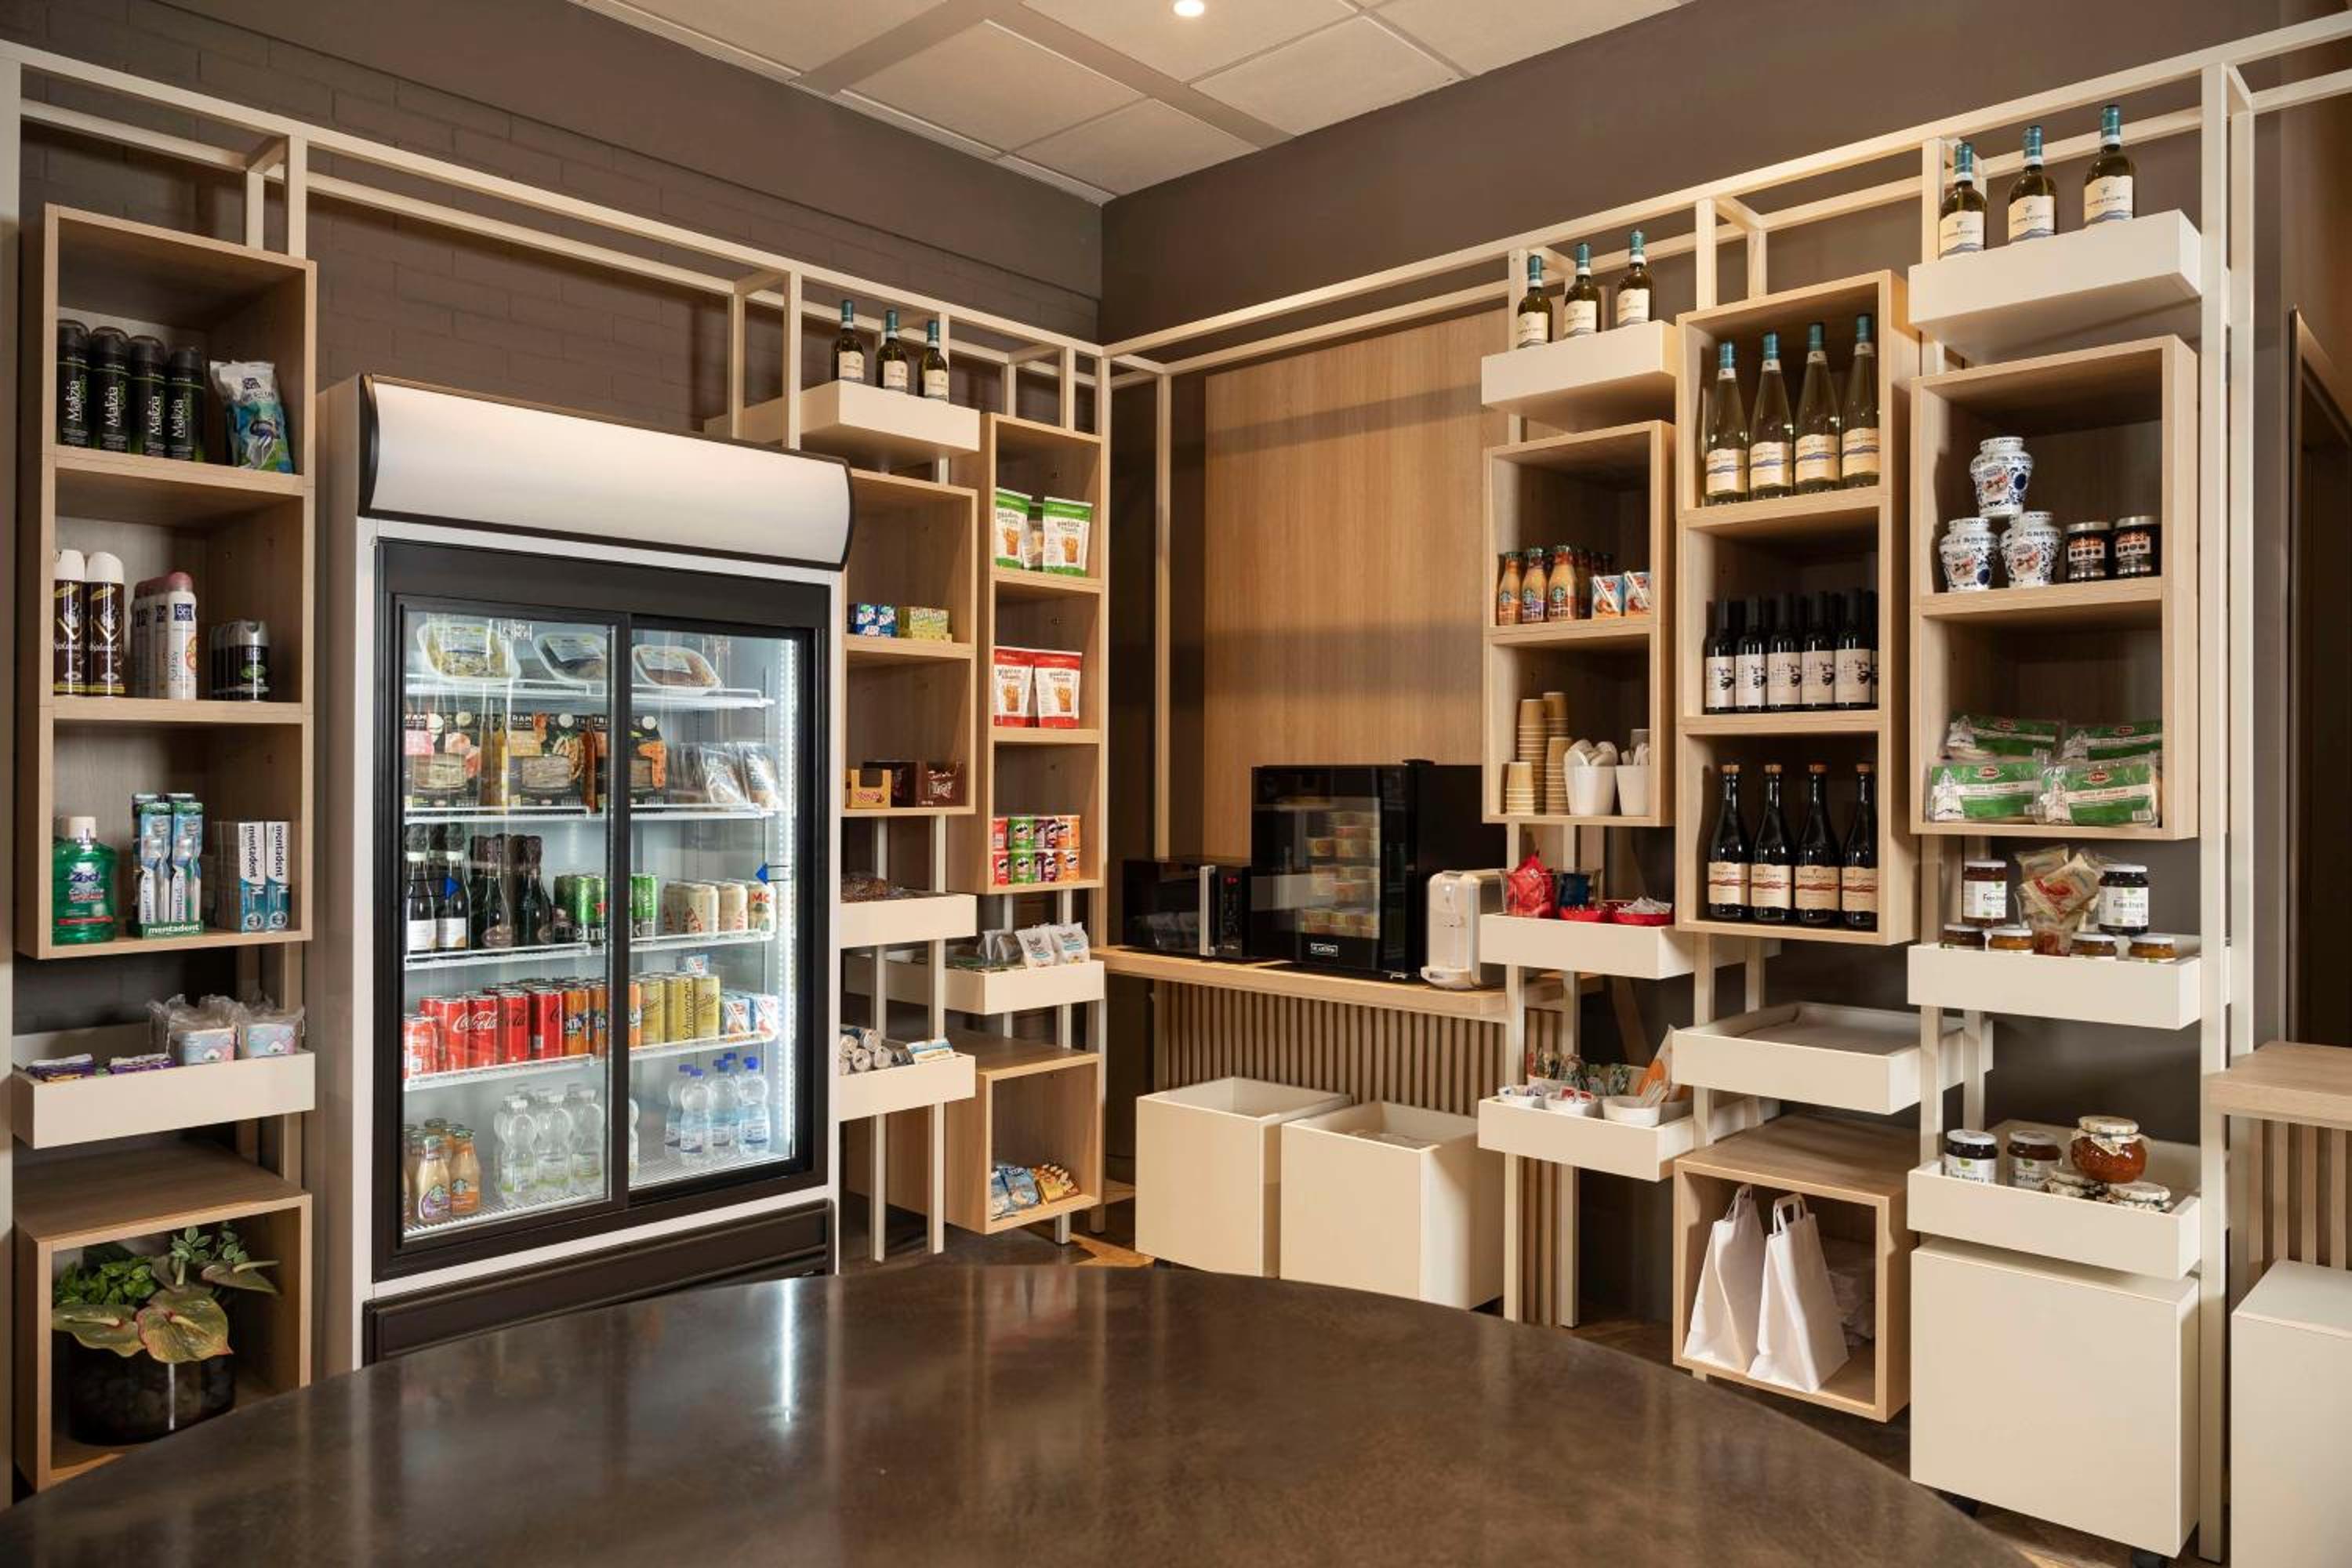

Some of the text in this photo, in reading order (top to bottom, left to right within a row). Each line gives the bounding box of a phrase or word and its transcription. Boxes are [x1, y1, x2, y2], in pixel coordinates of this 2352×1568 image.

[66, 379, 82, 423] Malizia
[105, 387, 121, 426] Malizia
[148, 396, 162, 436] Malizia
[170, 398, 186, 438] Malizia
[247, 826, 258, 878] mentadent
[275, 826, 285, 877] mentadent
[147, 924, 199, 934] mentadent
